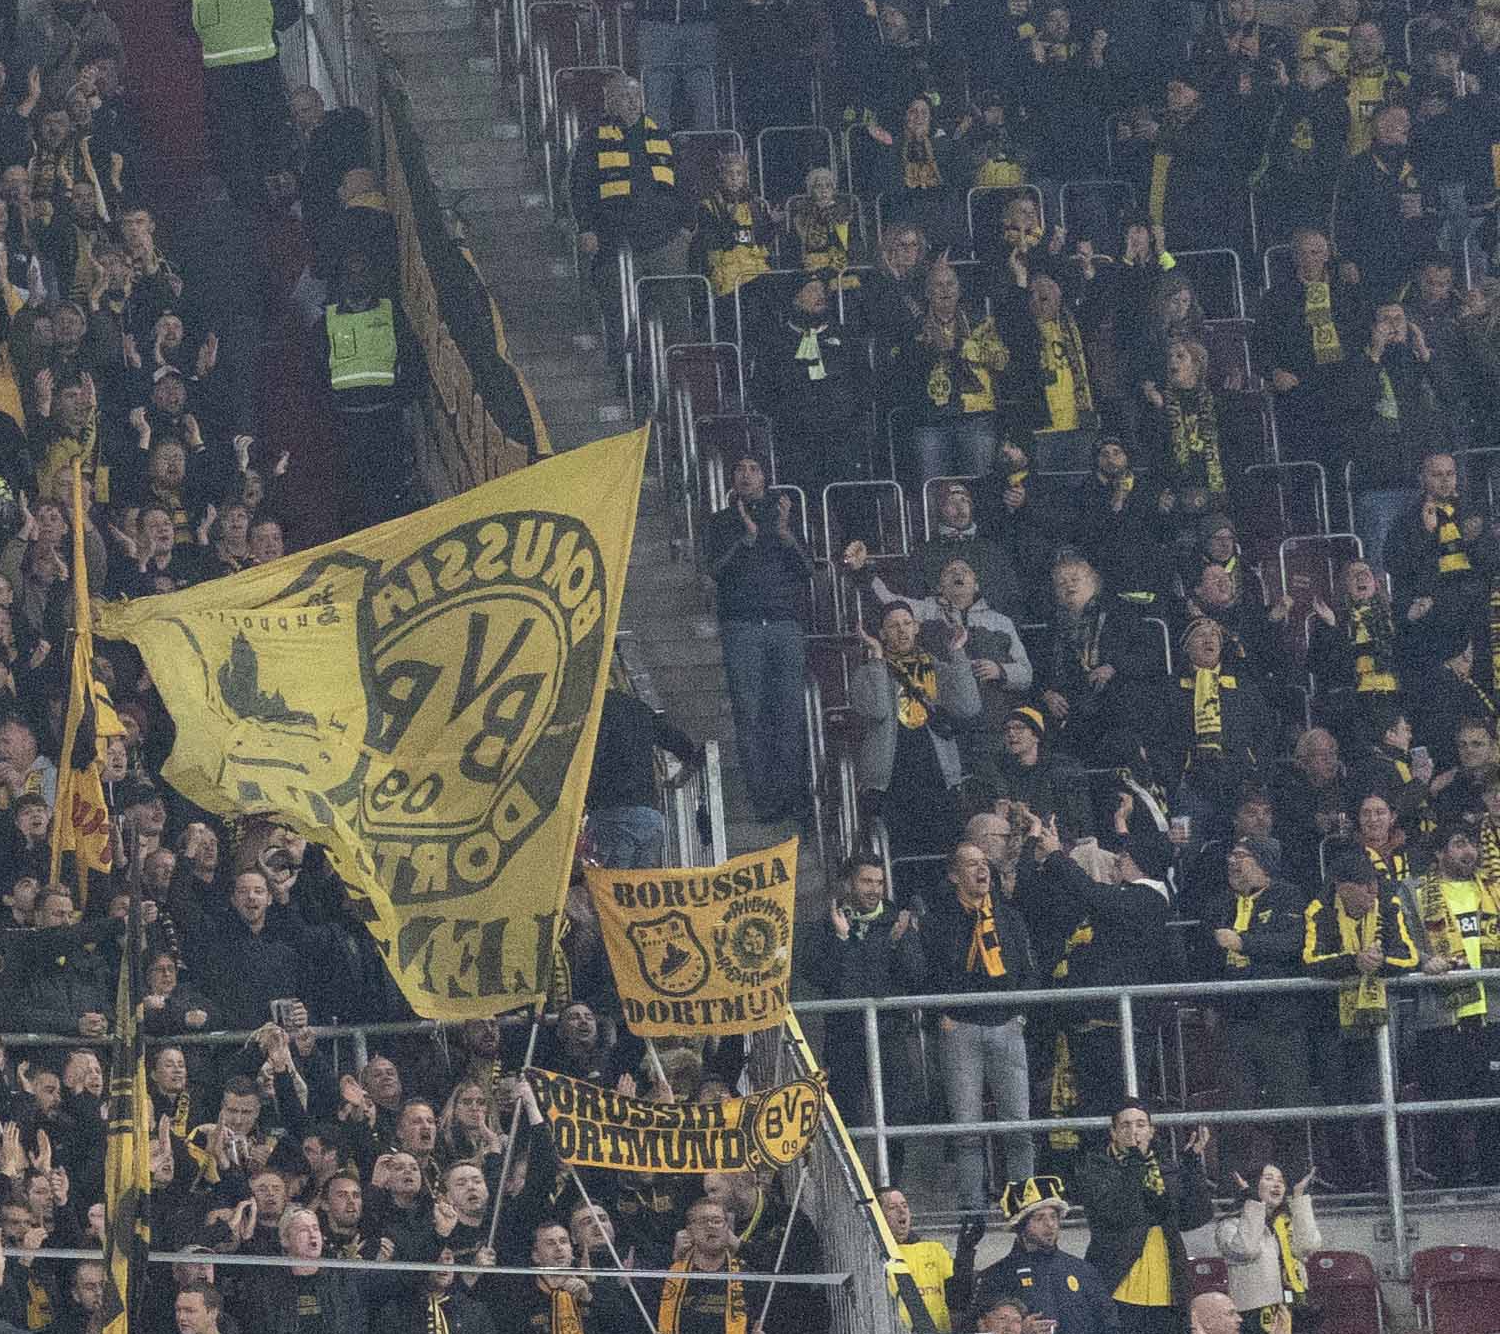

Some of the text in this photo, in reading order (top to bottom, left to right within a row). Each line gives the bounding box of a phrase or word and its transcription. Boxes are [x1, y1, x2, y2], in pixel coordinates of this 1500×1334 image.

[612, 858, 790, 909] BORUSSIA
[625, 982, 788, 1026] DORTMUN
[554, 1118, 748, 1169] ORTMUND
